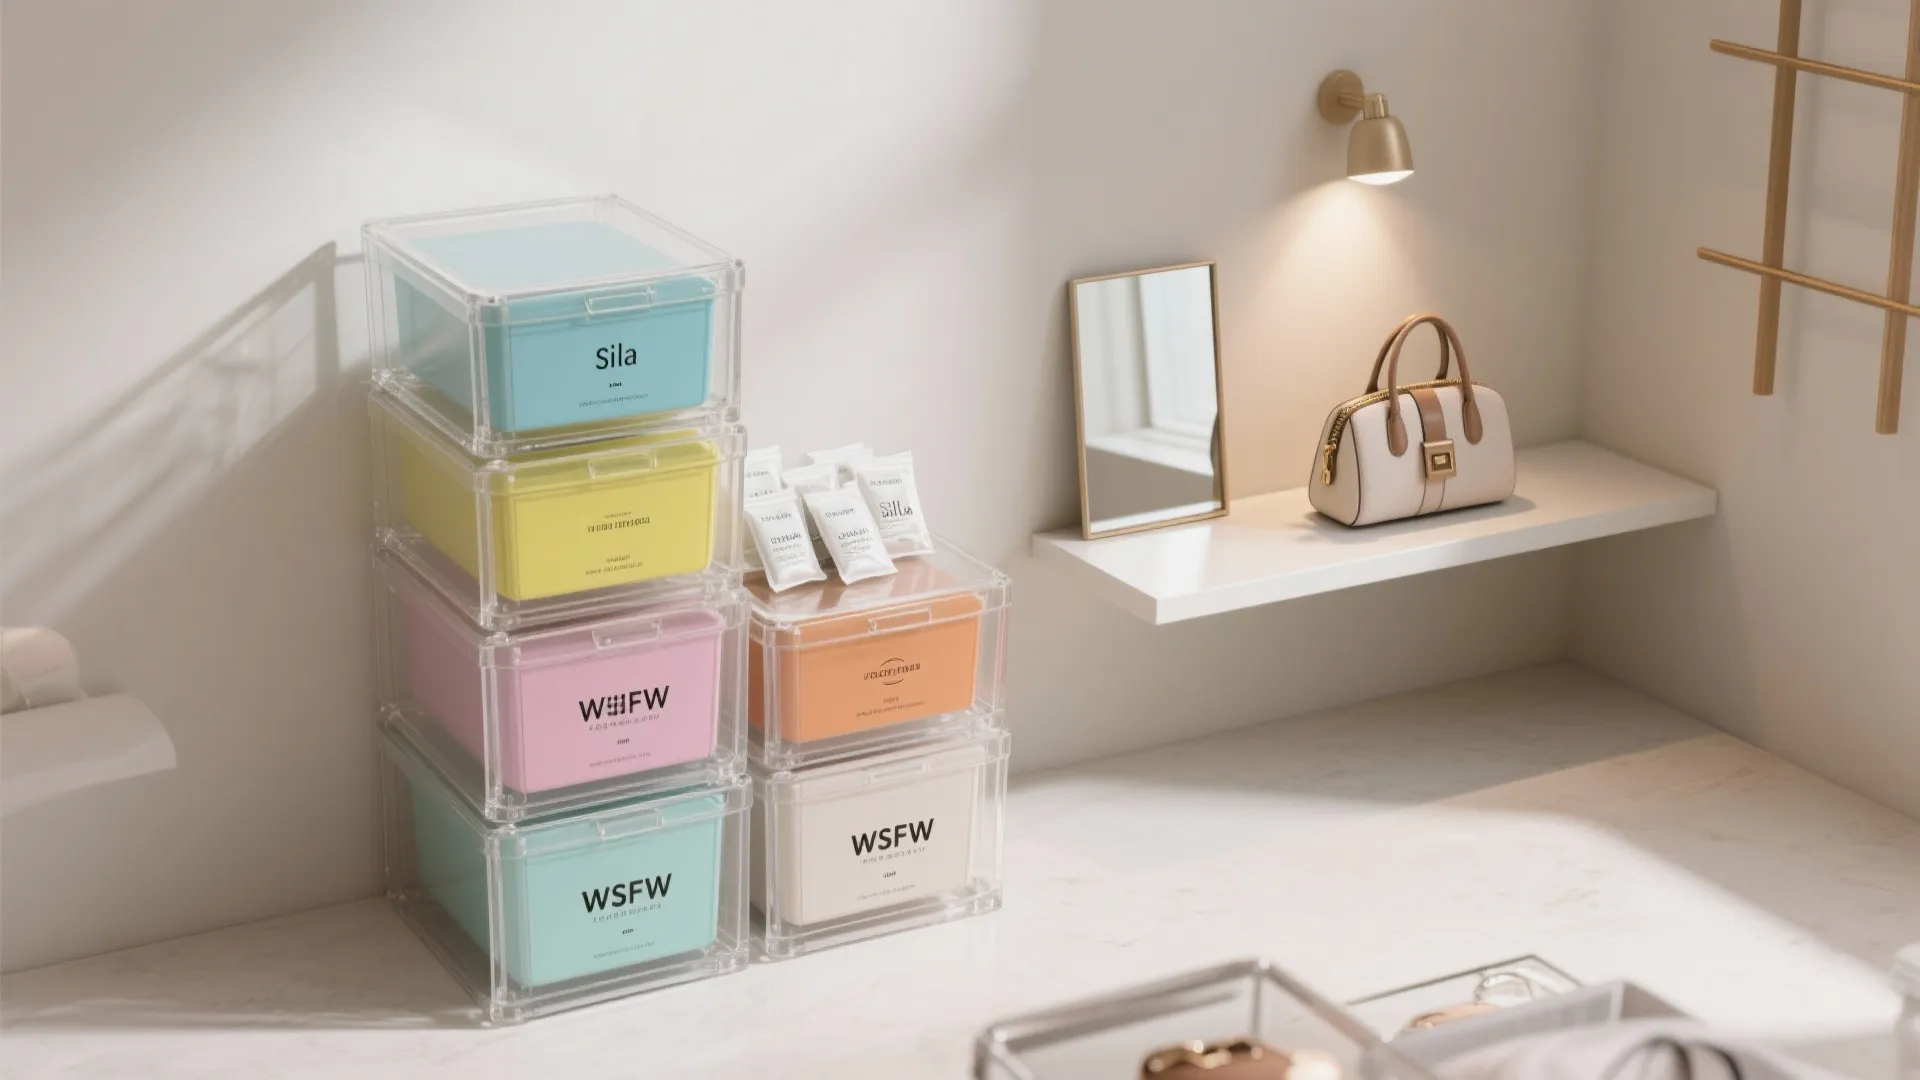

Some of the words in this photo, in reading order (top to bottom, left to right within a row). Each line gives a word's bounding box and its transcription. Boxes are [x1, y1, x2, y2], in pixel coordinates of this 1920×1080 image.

[595, 342, 637, 370] Sila
[851, 817, 934, 857] WSFW
[581, 872, 672, 914] WSFW
